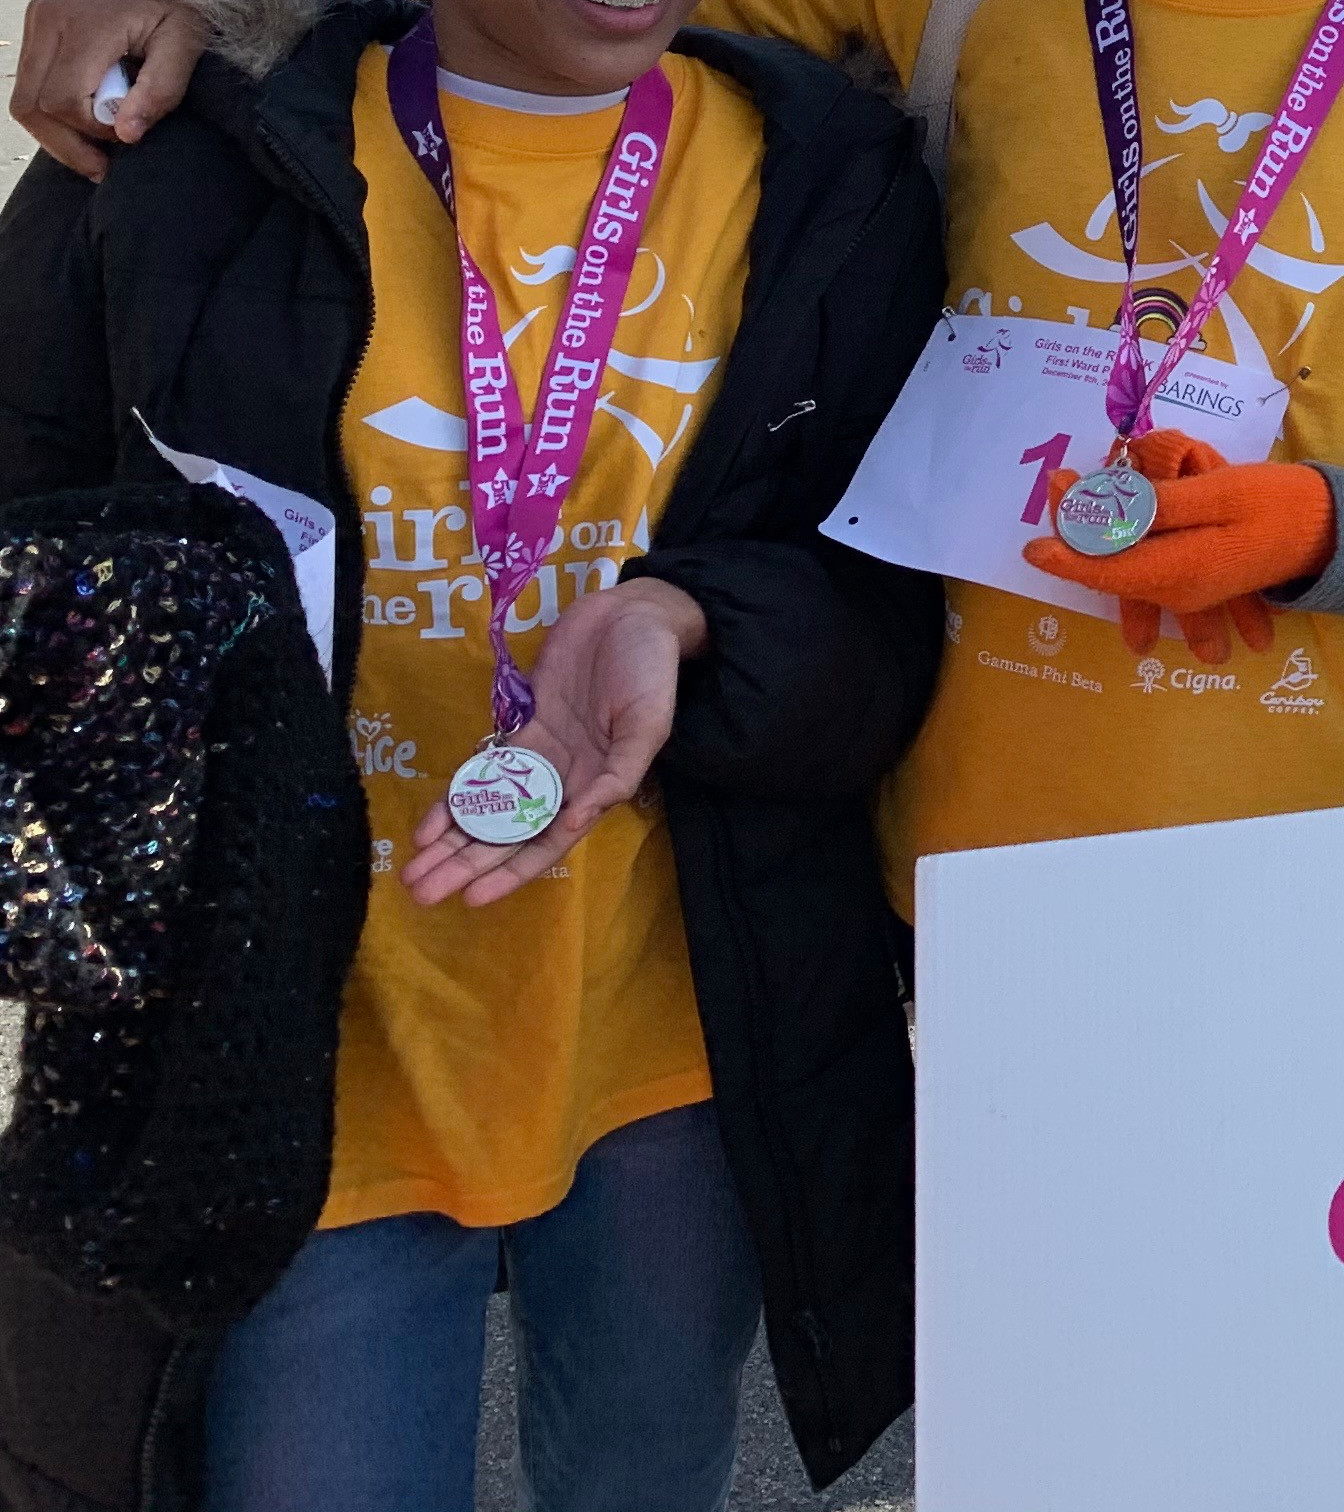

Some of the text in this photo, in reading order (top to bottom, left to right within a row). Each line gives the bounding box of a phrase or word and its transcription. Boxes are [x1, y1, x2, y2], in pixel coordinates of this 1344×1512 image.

[1307, 25, 1340, 64] on
[1111, 47, 1133, 100] the
[1287, 62, 1327, 113] the
[1248, 110, 1314, 200] Run
[535, 131, 660, 456] Girls on the Run
[465, 284, 487, 346] the
[1034, 338, 1064, 354] Girls
[1065, 344, 1081, 356] on
[1082, 345, 1103, 360] the
[1045, 354, 1070, 369] First
[1070, 358, 1101, 373] Ward
[467, 351, 510, 463] Run
[1156, 378, 1246, 418] BARINGS
[1019, 432, 1072, 526] 1
[284, 508, 315, 530] Girls
[570, 519, 626, 551] on
[362, 593, 417, 626] he
[977, 650, 1104, 694] Gamma Phi Beta
[450, 788, 501, 808] Girls
[476, 799, 517, 816] run
